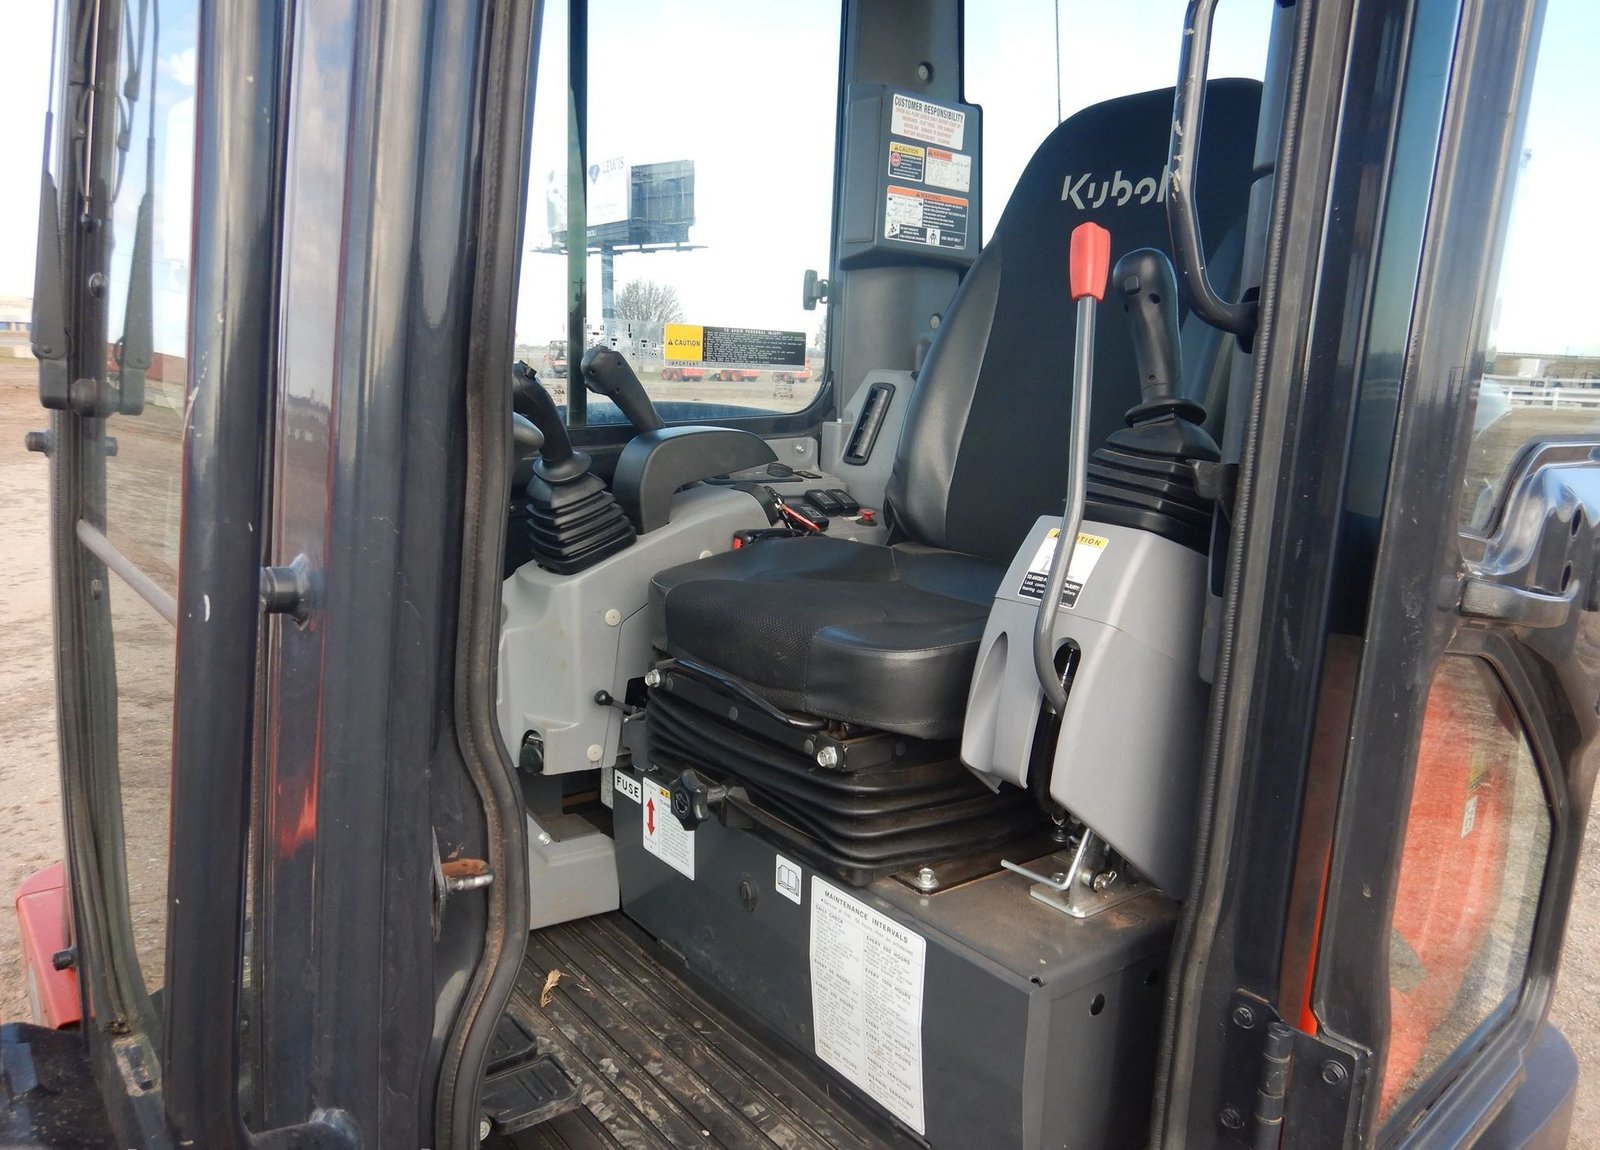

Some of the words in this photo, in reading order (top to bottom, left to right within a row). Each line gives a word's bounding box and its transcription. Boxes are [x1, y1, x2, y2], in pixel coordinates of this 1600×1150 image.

[894, 95, 924, 113] CUSTOMER
[924, 102, 964, 124] RESPONSIBILITY
[898, 146, 919, 155] CAUTION
[1060, 164, 1169, 210] Kubo
[674, 339, 701, 348] CAUTION
[1077, 535, 1101, 546] TION
[616, 775, 639, 798] FUSE
[824, 890, 868, 920] MAINTENANCE
[872, 918, 908, 944] INTERVALS
[866, 935, 881, 948] EVERY
[893, 952, 910, 966] HOURS
